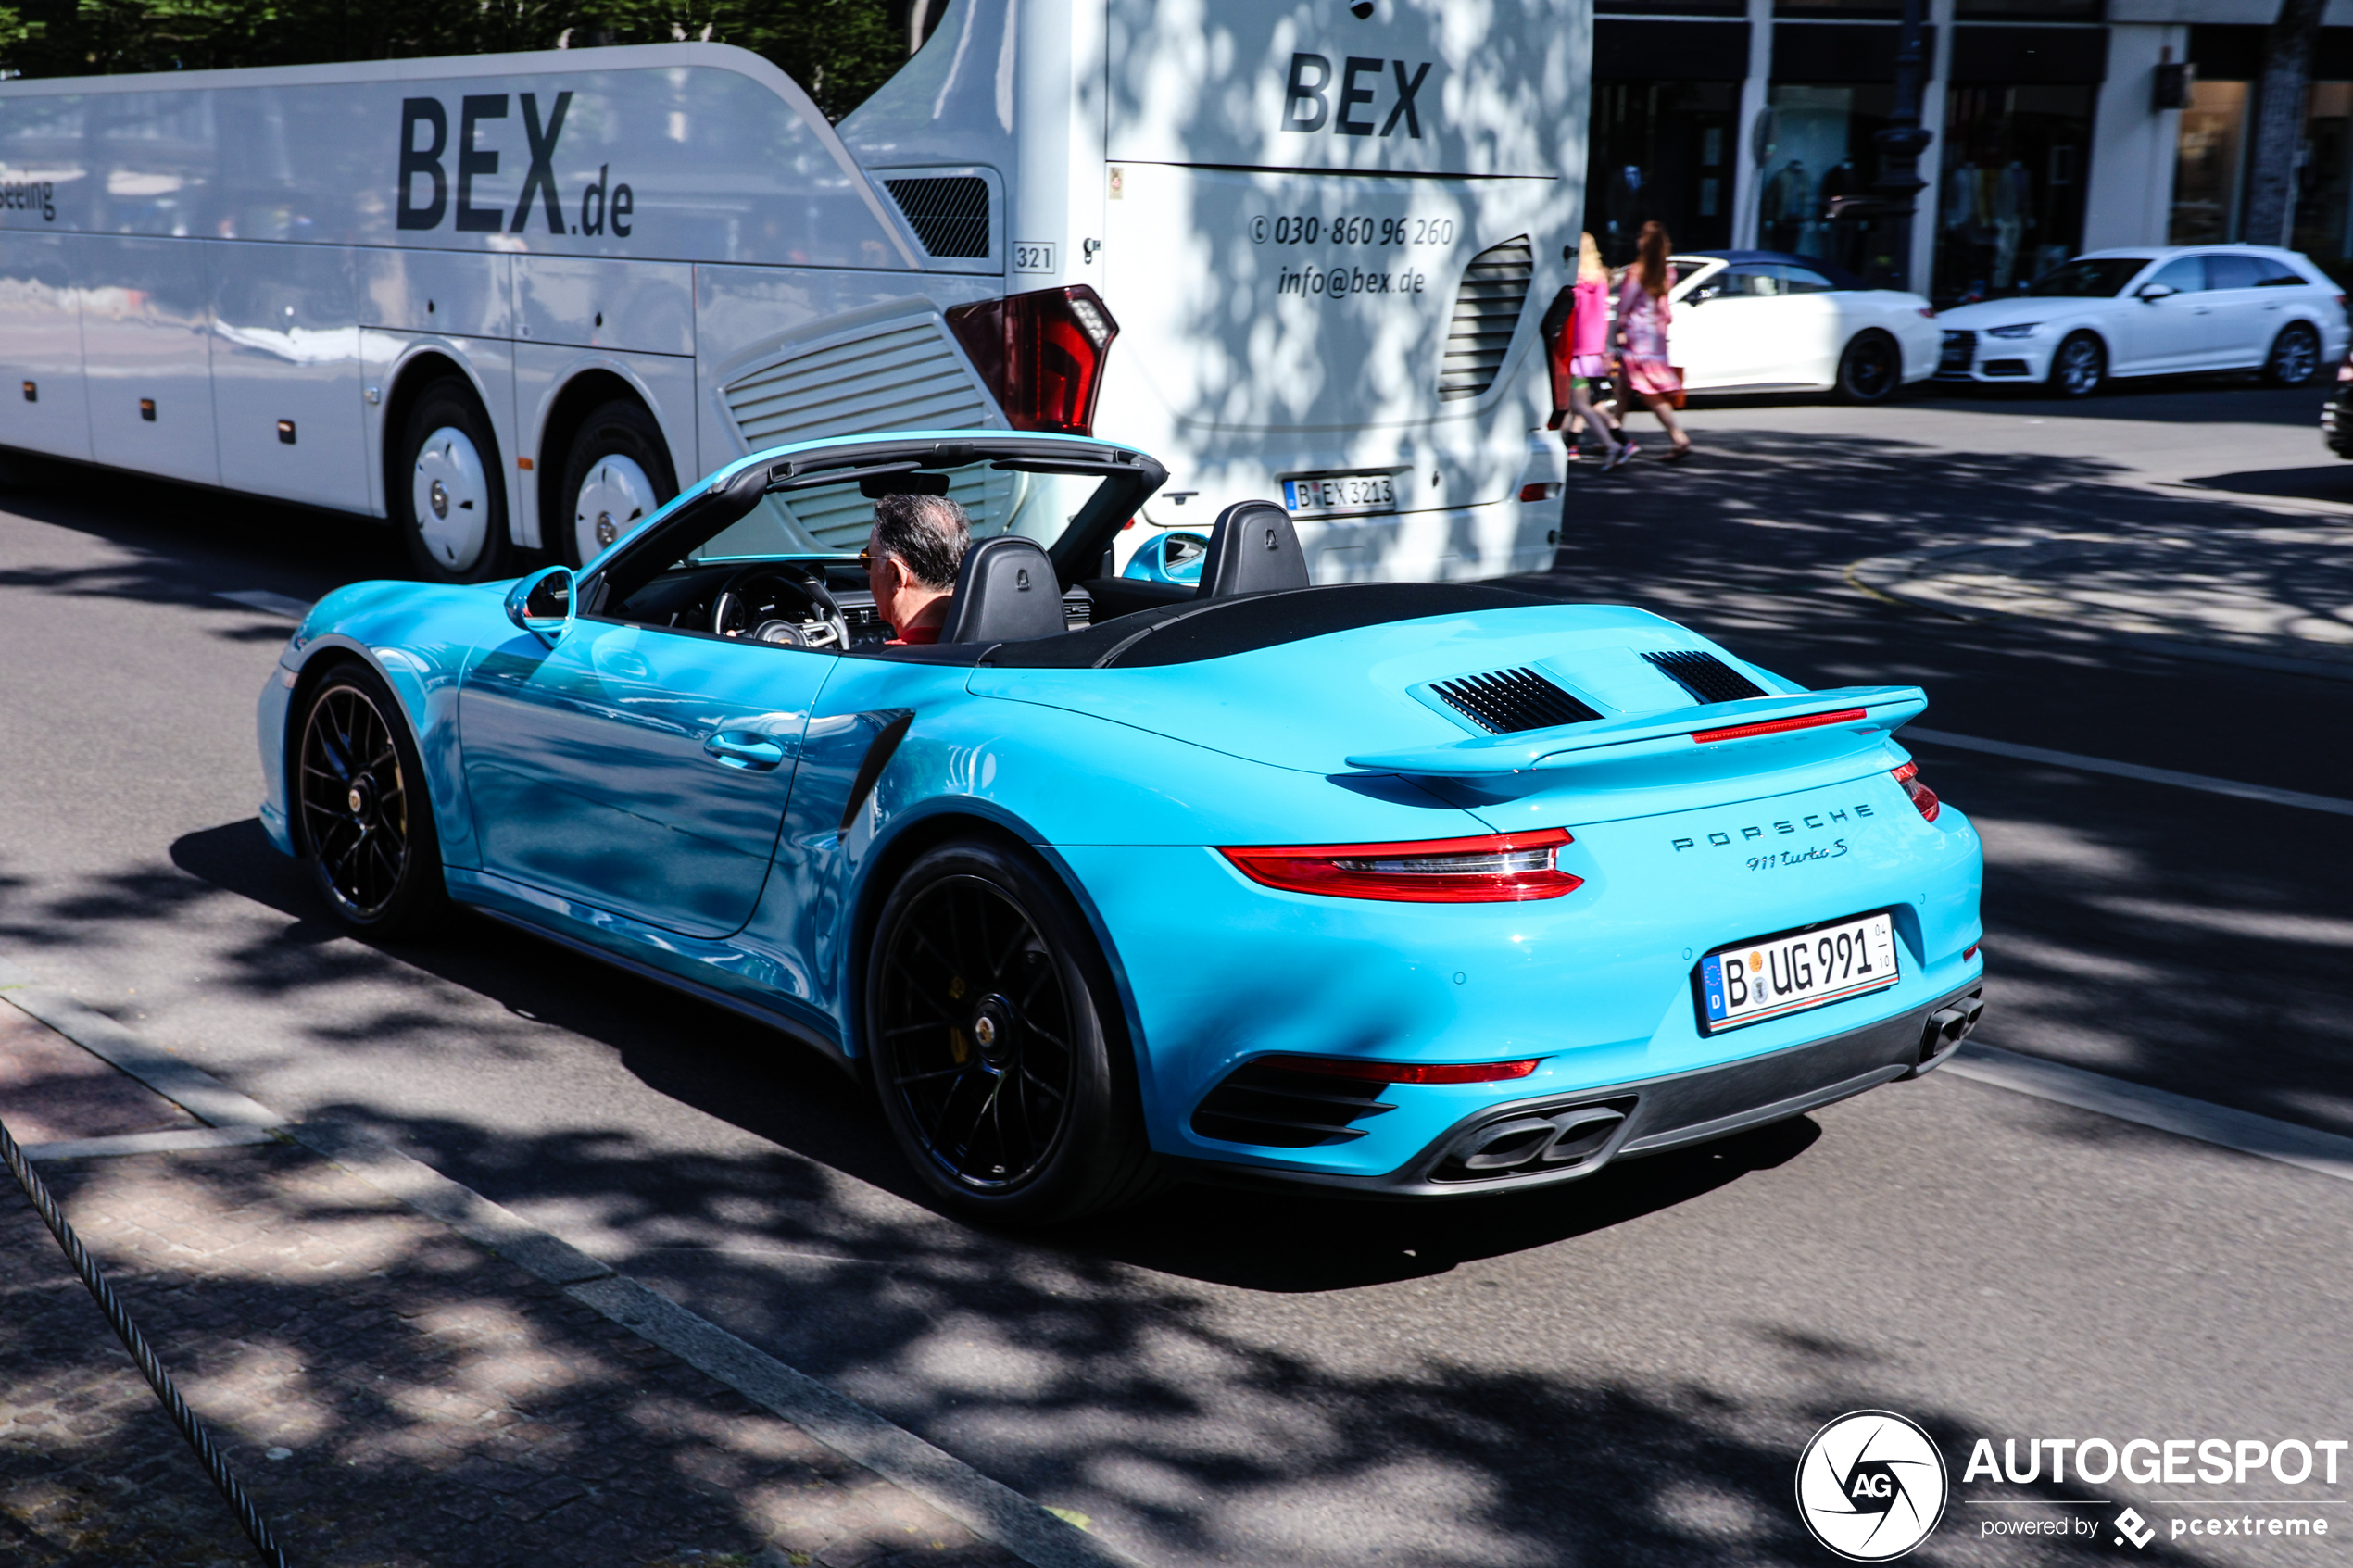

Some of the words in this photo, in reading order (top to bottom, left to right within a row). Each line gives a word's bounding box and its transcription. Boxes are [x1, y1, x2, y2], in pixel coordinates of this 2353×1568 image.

[1280, 52, 1433, 139] BEX
[396, 91, 634, 238] BEX.de
[1379, 217, 1408, 245] 96
[1413, 218, 1453, 245] 260
[1016, 247, 1051, 269] 321
[1278, 265, 1425, 299] info@bex.de
[1298, 484, 1310, 507] B
[1322, 483, 1347, 506] EX
[1350, 480, 1391, 504] 3213
[1671, 804, 1874, 852] PORSCHE
[1746, 855, 1776, 872] 911
[1830, 839, 1848, 858] S
[1875, 923, 1886, 936] 04
[1725, 959, 1748, 1008] B
[1769, 943, 1813, 996] UG
[1818, 928, 1873, 984] 991
[1880, 954, 1890, 969] 10
[1711, 994, 1721, 1010] D
